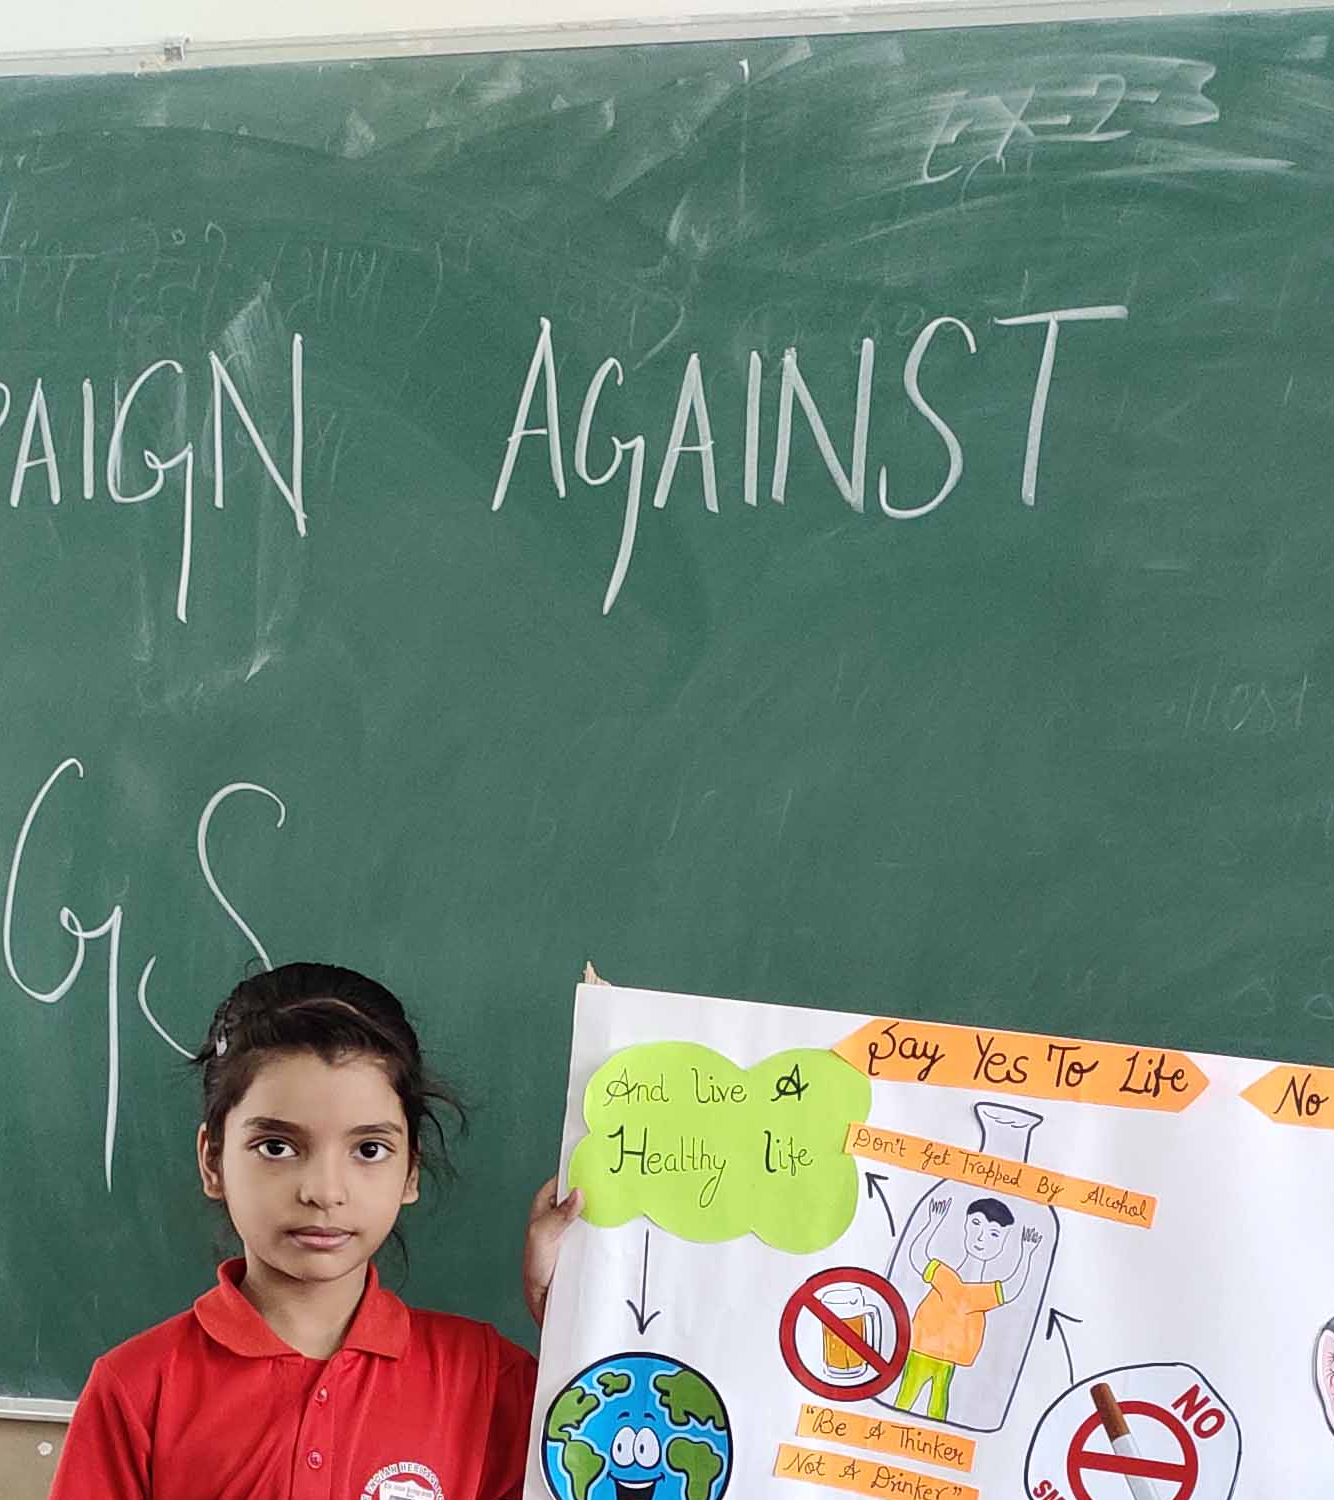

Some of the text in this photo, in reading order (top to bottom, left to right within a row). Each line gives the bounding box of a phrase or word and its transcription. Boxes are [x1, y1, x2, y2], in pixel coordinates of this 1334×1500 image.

[492, 305, 1130, 616] AGAINST
[603, 1068, 670, 1107] And
[770, 1063, 810, 1103] A
[868, 1022, 1190, 1098] Say Yes To Life
[1273, 1073, 1330, 1118] No
[607, 1124, 727, 1209] Healthy
[852, 1127, 908, 1158] Don't
[959, 1150, 1021, 1188] Trapped
[1036, 1175, 1065, 1198] By
[1079, 1185, 1148, 1221] Alcohol
[1170, 1383, 1226, 1440] NO
[782, 1452, 826, 1477] Not
[838, 1458, 861, 1481] A
[864, 1420, 886, 1441] A
[890, 1424, 965, 1466] Thinker
